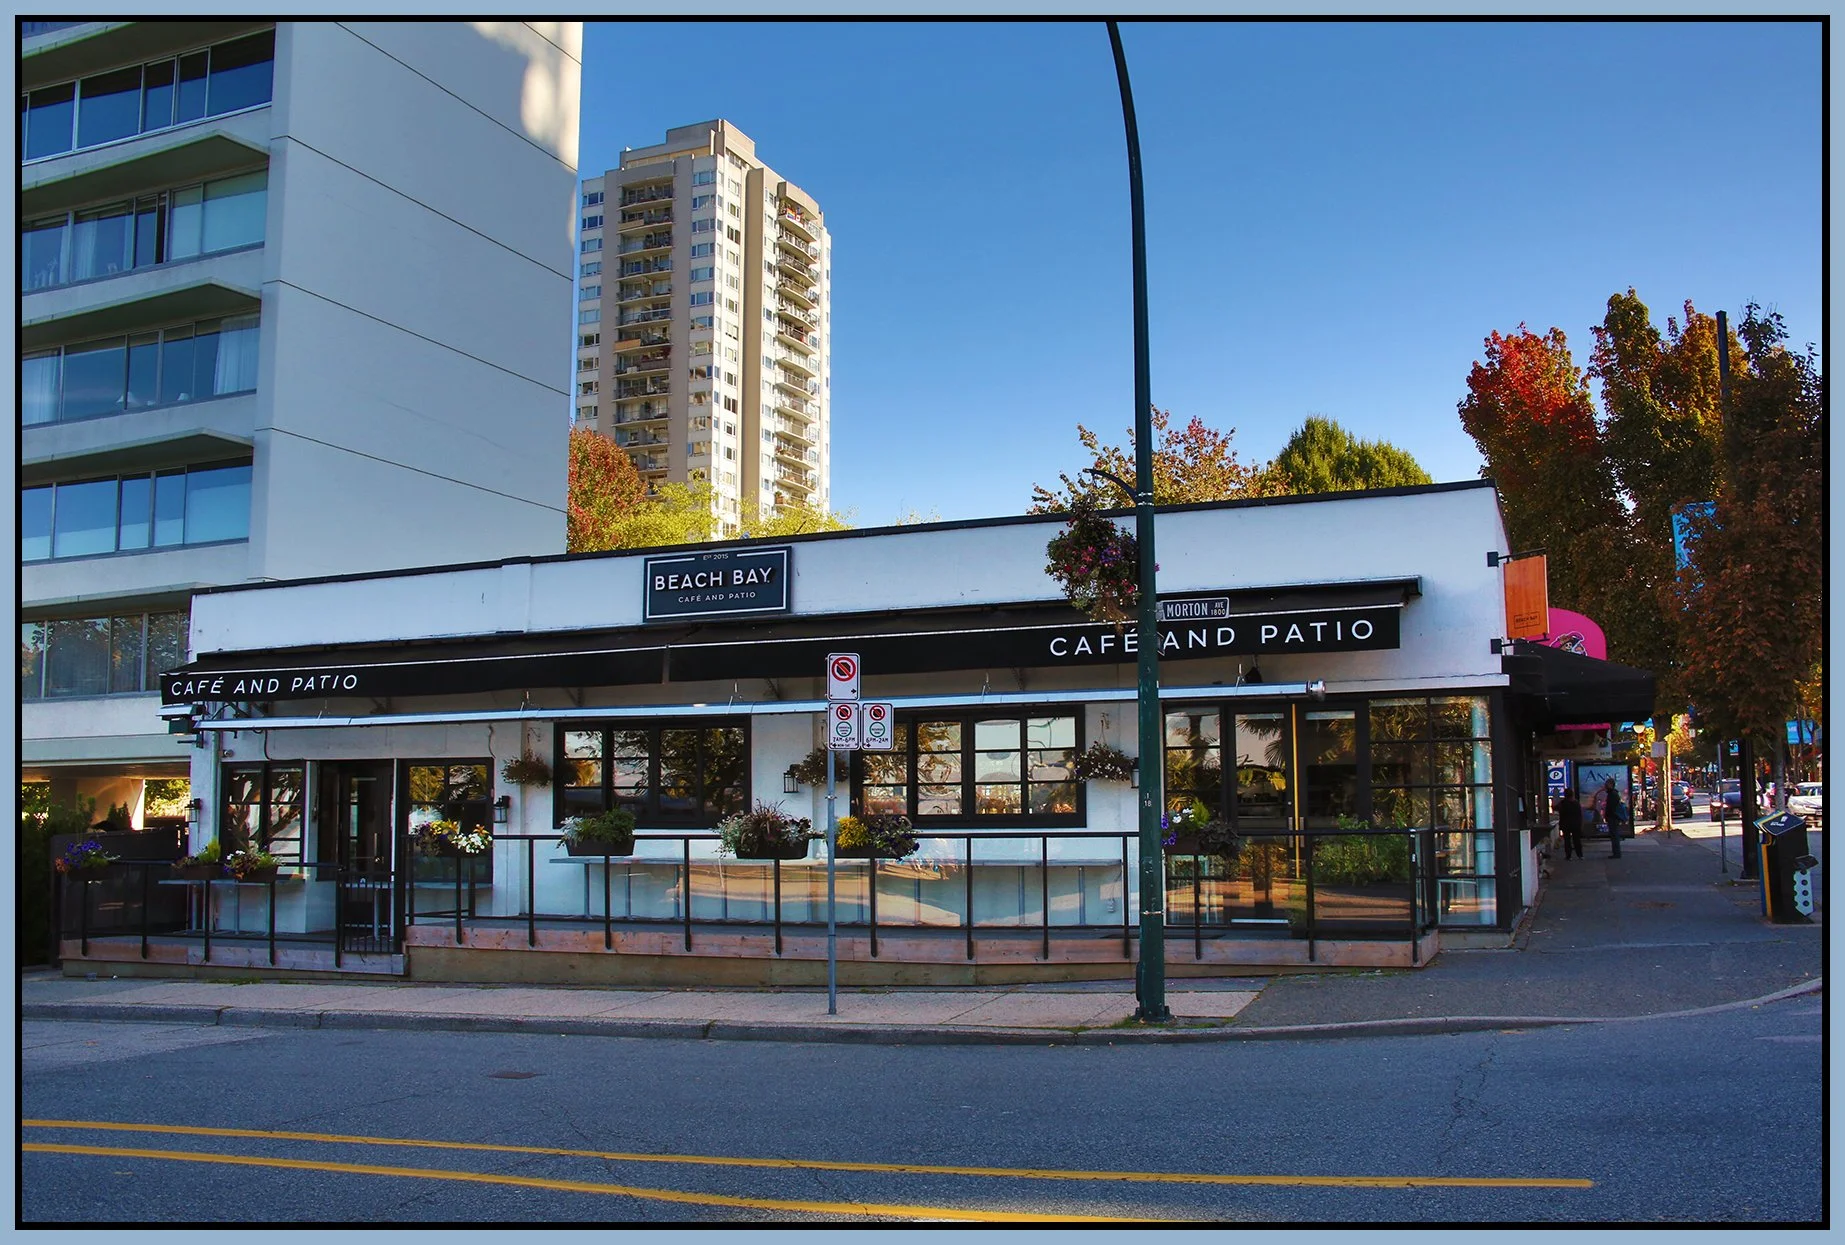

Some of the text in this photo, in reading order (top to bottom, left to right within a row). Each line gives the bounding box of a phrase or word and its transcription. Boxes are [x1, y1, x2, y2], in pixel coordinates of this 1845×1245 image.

[654, 567, 772, 591] BEACH BAY
[678, 591, 756, 603] CAFÉ AND PATIO
[1166, 601, 1224, 617] MORTON AVE
[1210, 608, 1225, 616] 1800
[1049, 619, 1373, 656] CAFÉ AND PATIO
[171, 674, 358, 696] CAFÉ AND PATIO
